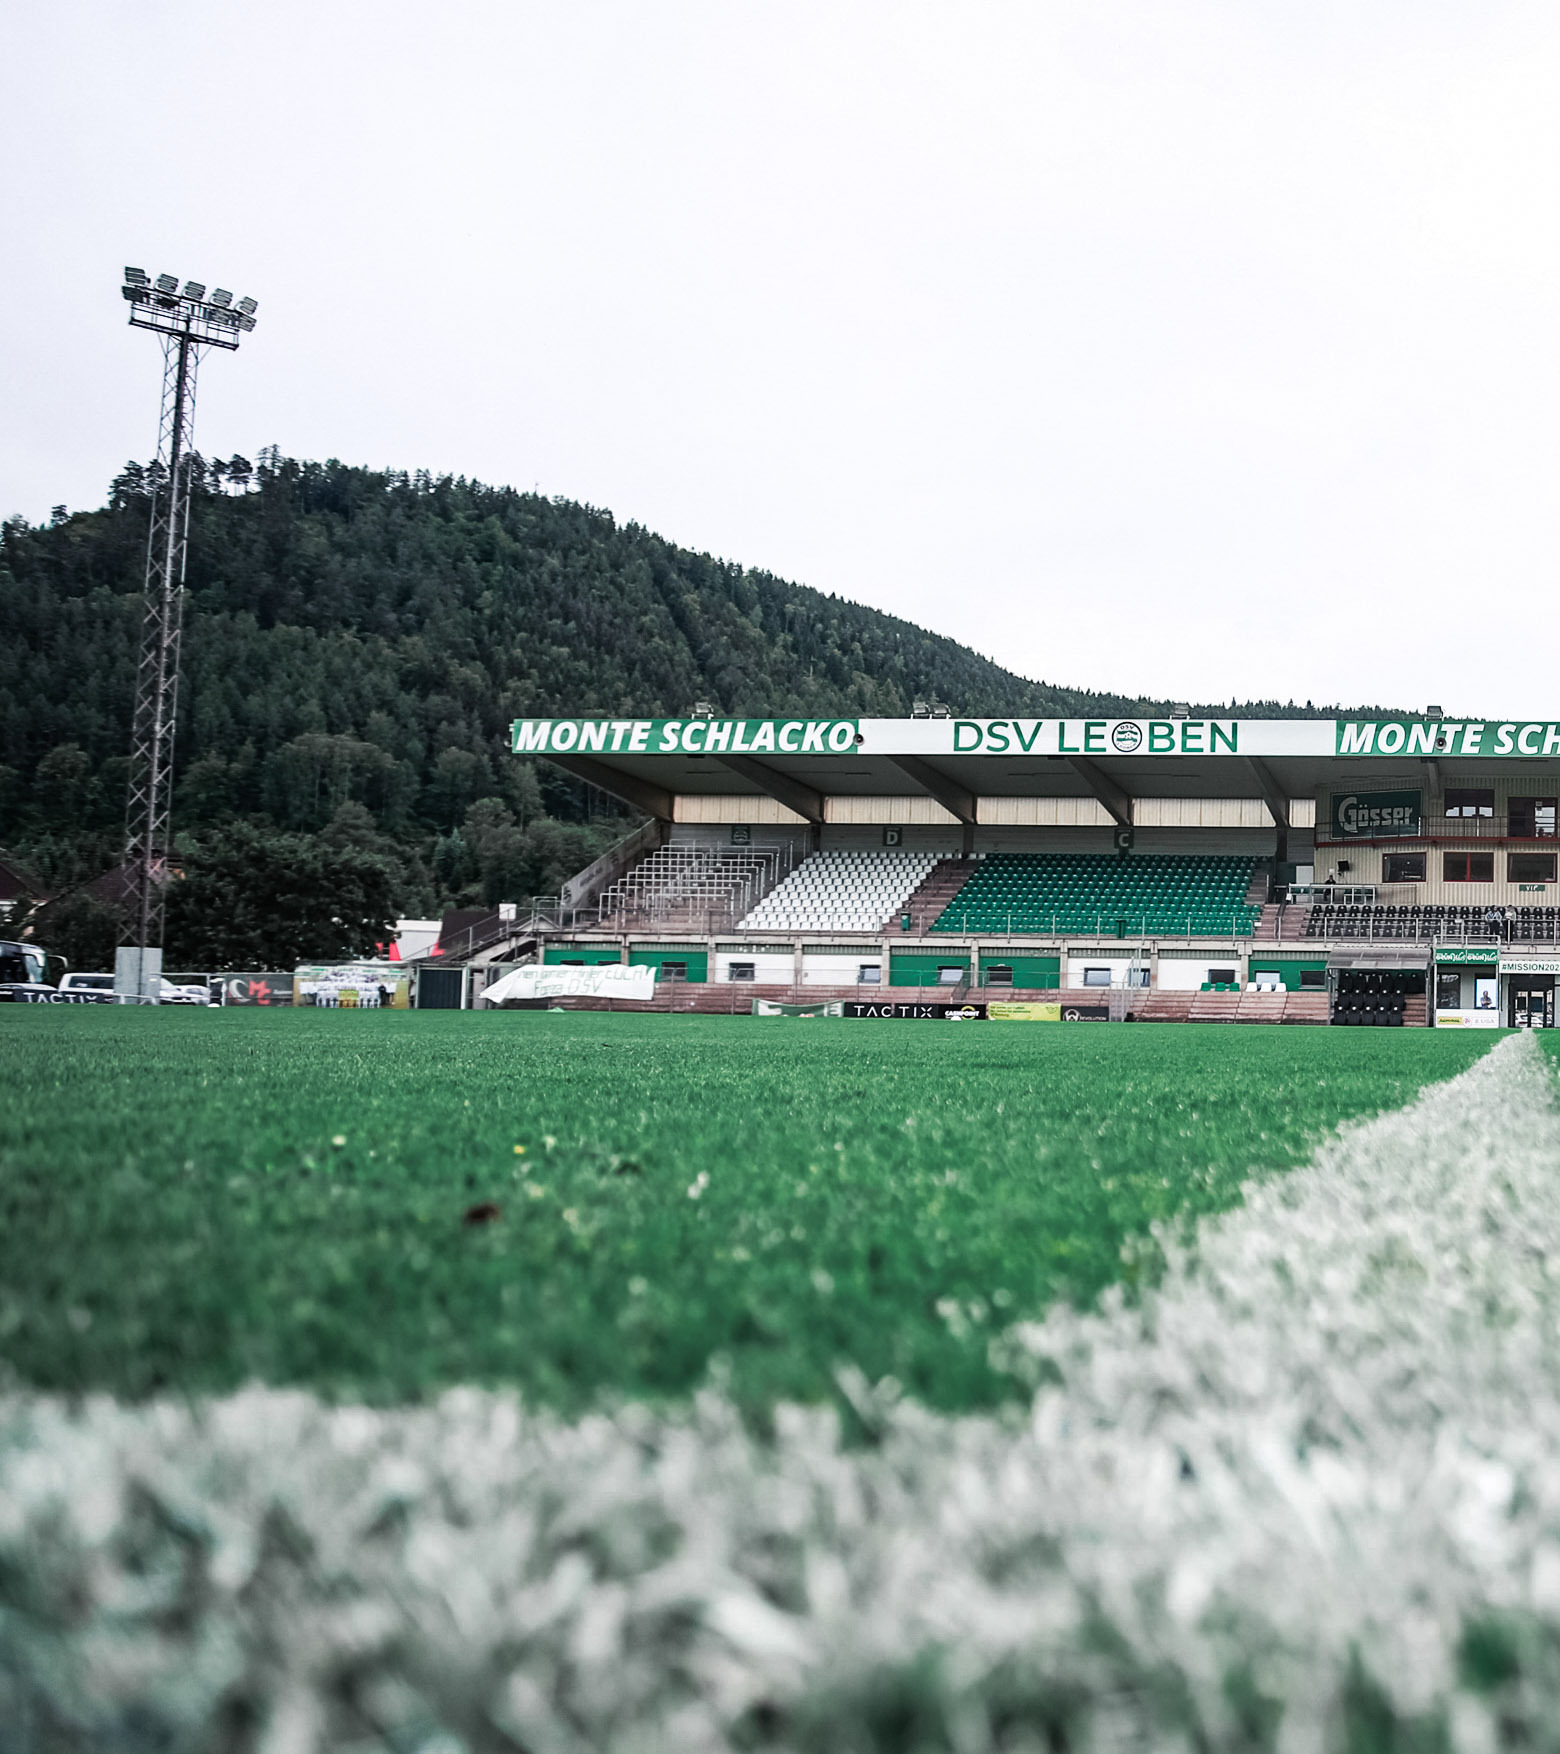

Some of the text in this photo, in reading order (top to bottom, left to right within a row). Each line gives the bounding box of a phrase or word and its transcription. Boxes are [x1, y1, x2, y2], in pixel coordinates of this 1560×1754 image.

[514, 721, 855, 753] MONTE SCHLACKO
[953, 721, 1043, 753] DSV
[1339, 723, 1486, 754] MONTE
[1338, 796, 1413, 833] Gösser
[886, 831, 899, 845] D
[1118, 833, 1129, 847] C
[568, 978, 604, 995] DSV
